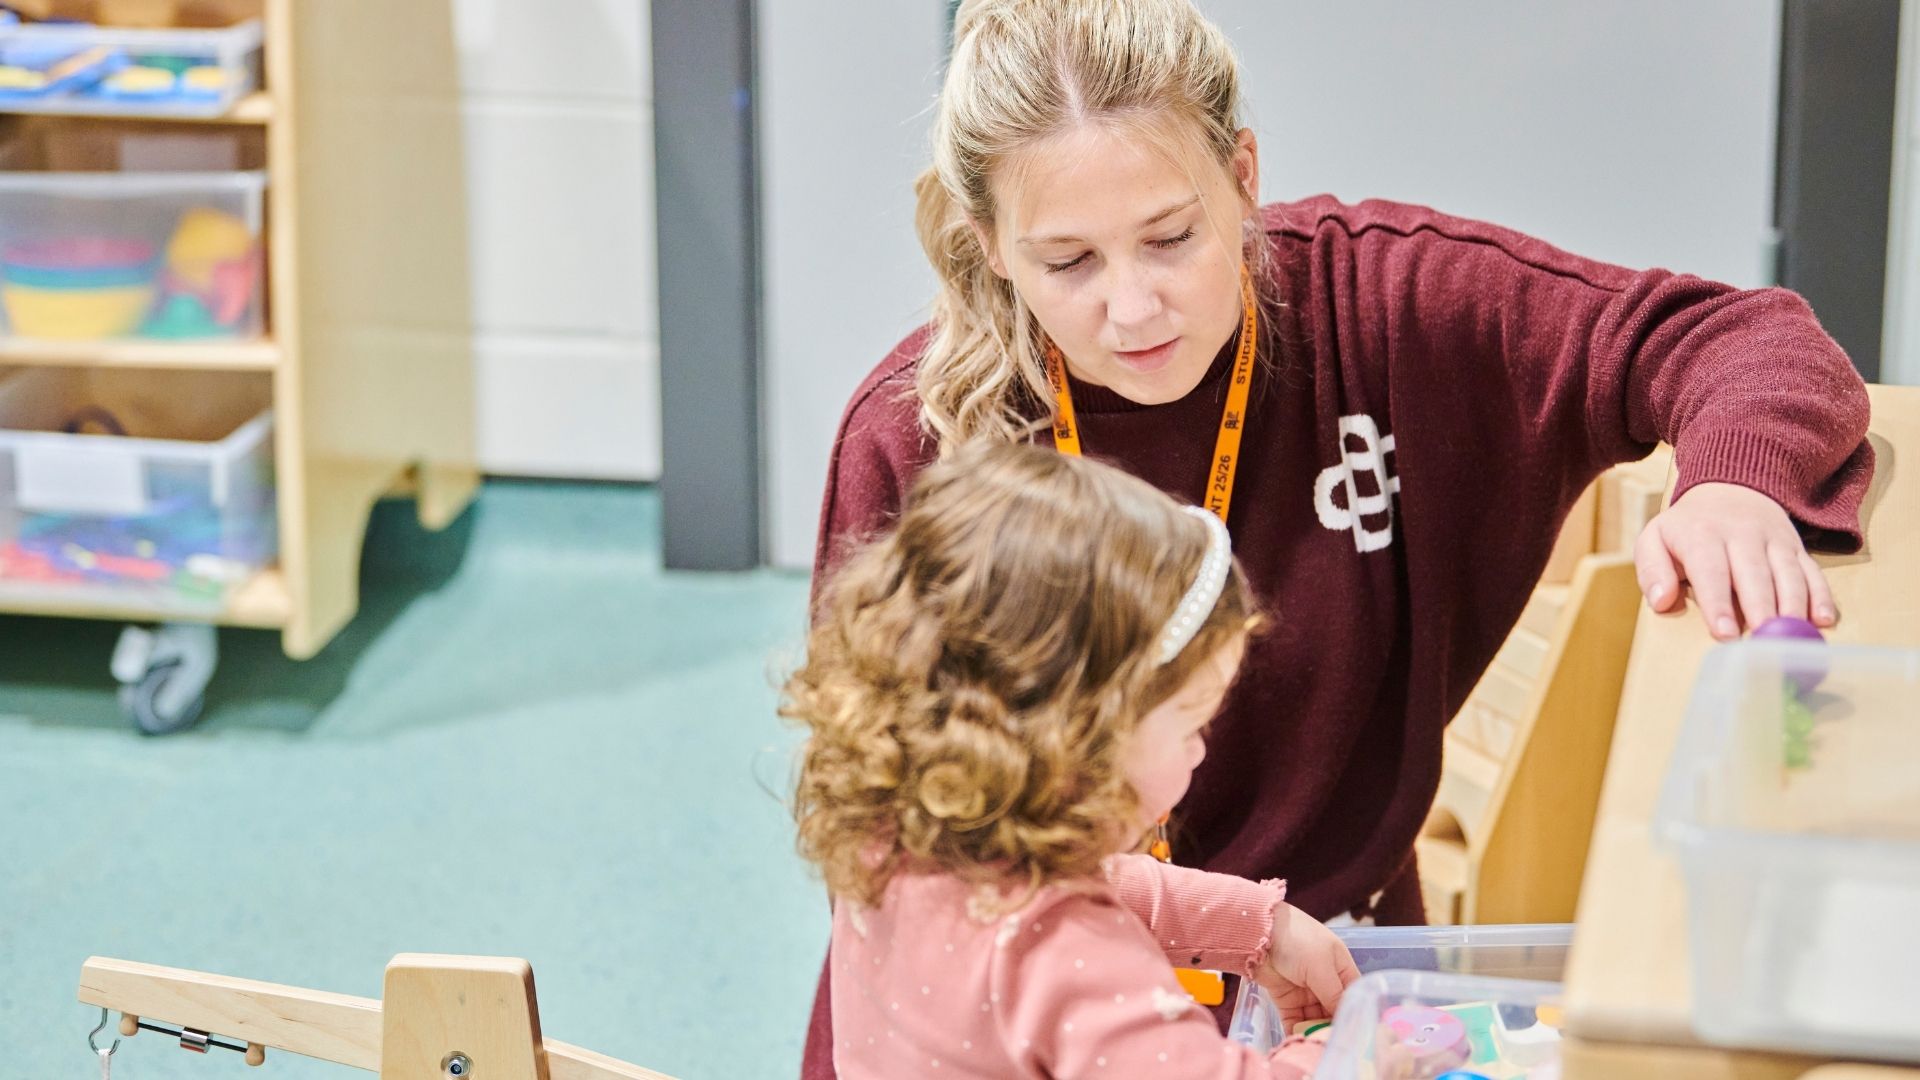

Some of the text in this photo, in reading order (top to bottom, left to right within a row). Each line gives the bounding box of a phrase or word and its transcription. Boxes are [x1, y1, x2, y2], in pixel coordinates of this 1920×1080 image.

[1236, 316, 1254, 385] STUDENT
[1210, 455, 1231, 516] NT 25/26
